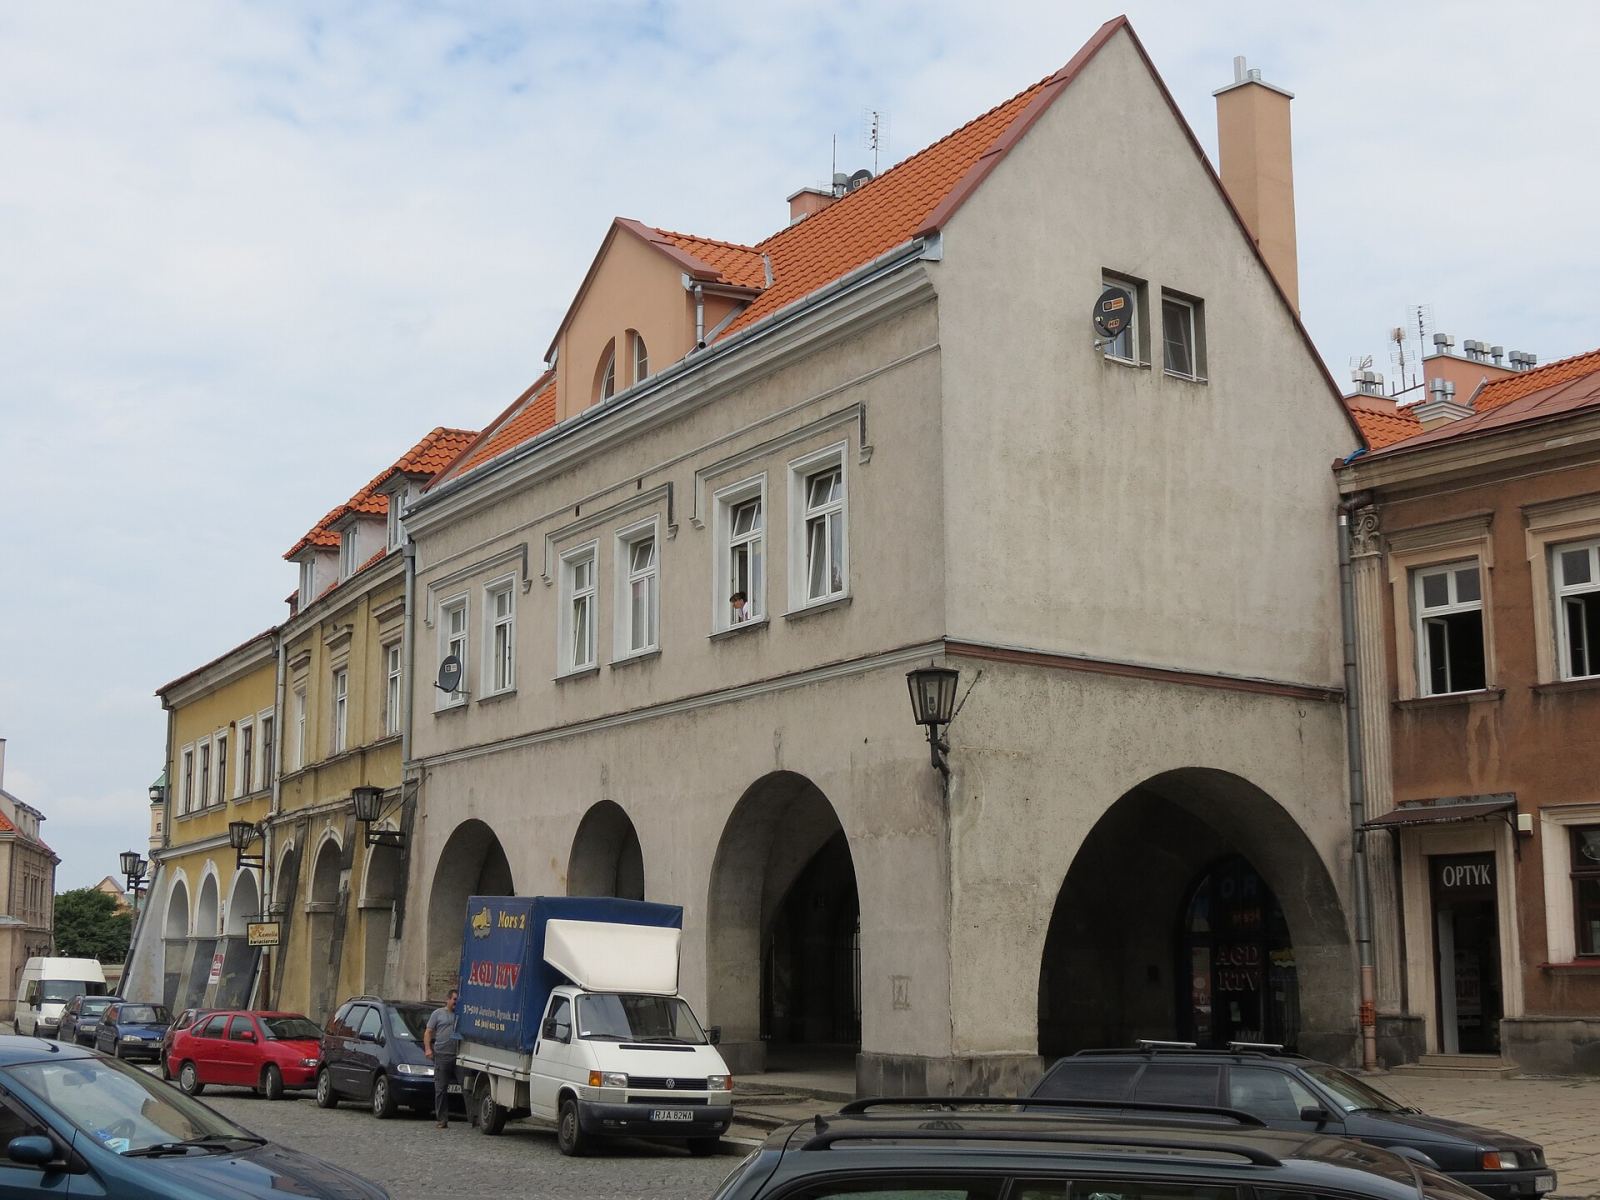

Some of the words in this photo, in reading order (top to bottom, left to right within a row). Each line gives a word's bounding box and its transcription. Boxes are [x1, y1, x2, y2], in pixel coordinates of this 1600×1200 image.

[1442, 864, 1491, 887] OPTYK
[497, 910, 518, 929] Nors
[519, 915, 526, 930] 2
[655, 1110, 671, 1120] RJA
